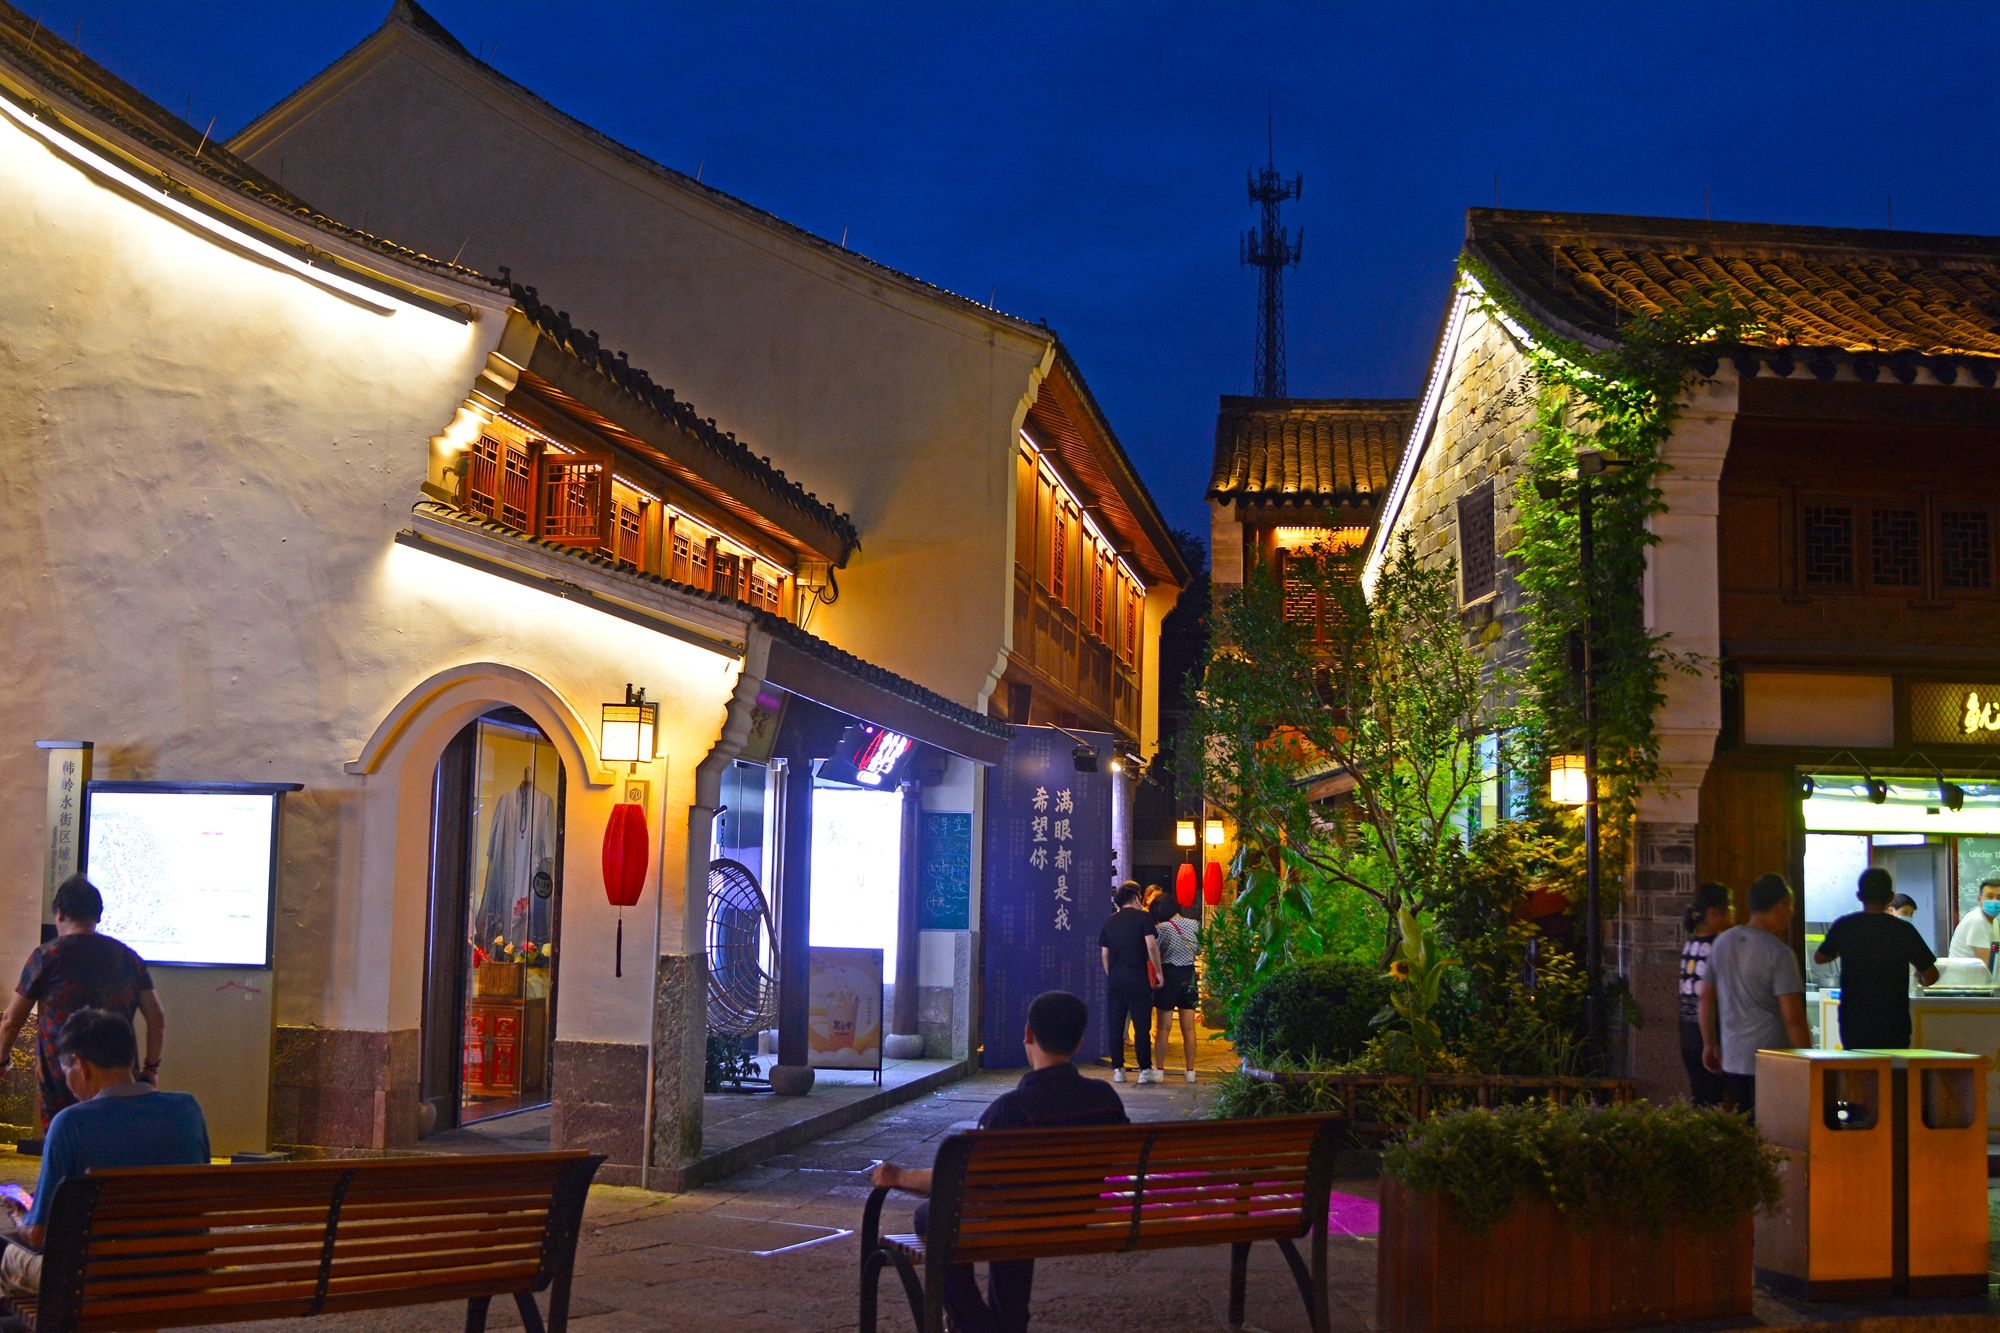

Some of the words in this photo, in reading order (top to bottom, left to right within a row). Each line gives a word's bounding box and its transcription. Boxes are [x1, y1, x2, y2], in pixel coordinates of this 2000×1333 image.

[1029, 786, 1050, 871] 希望你
[1054, 788, 1074, 931] 满眼都是我
[1968, 850, 1993, 858] Under
